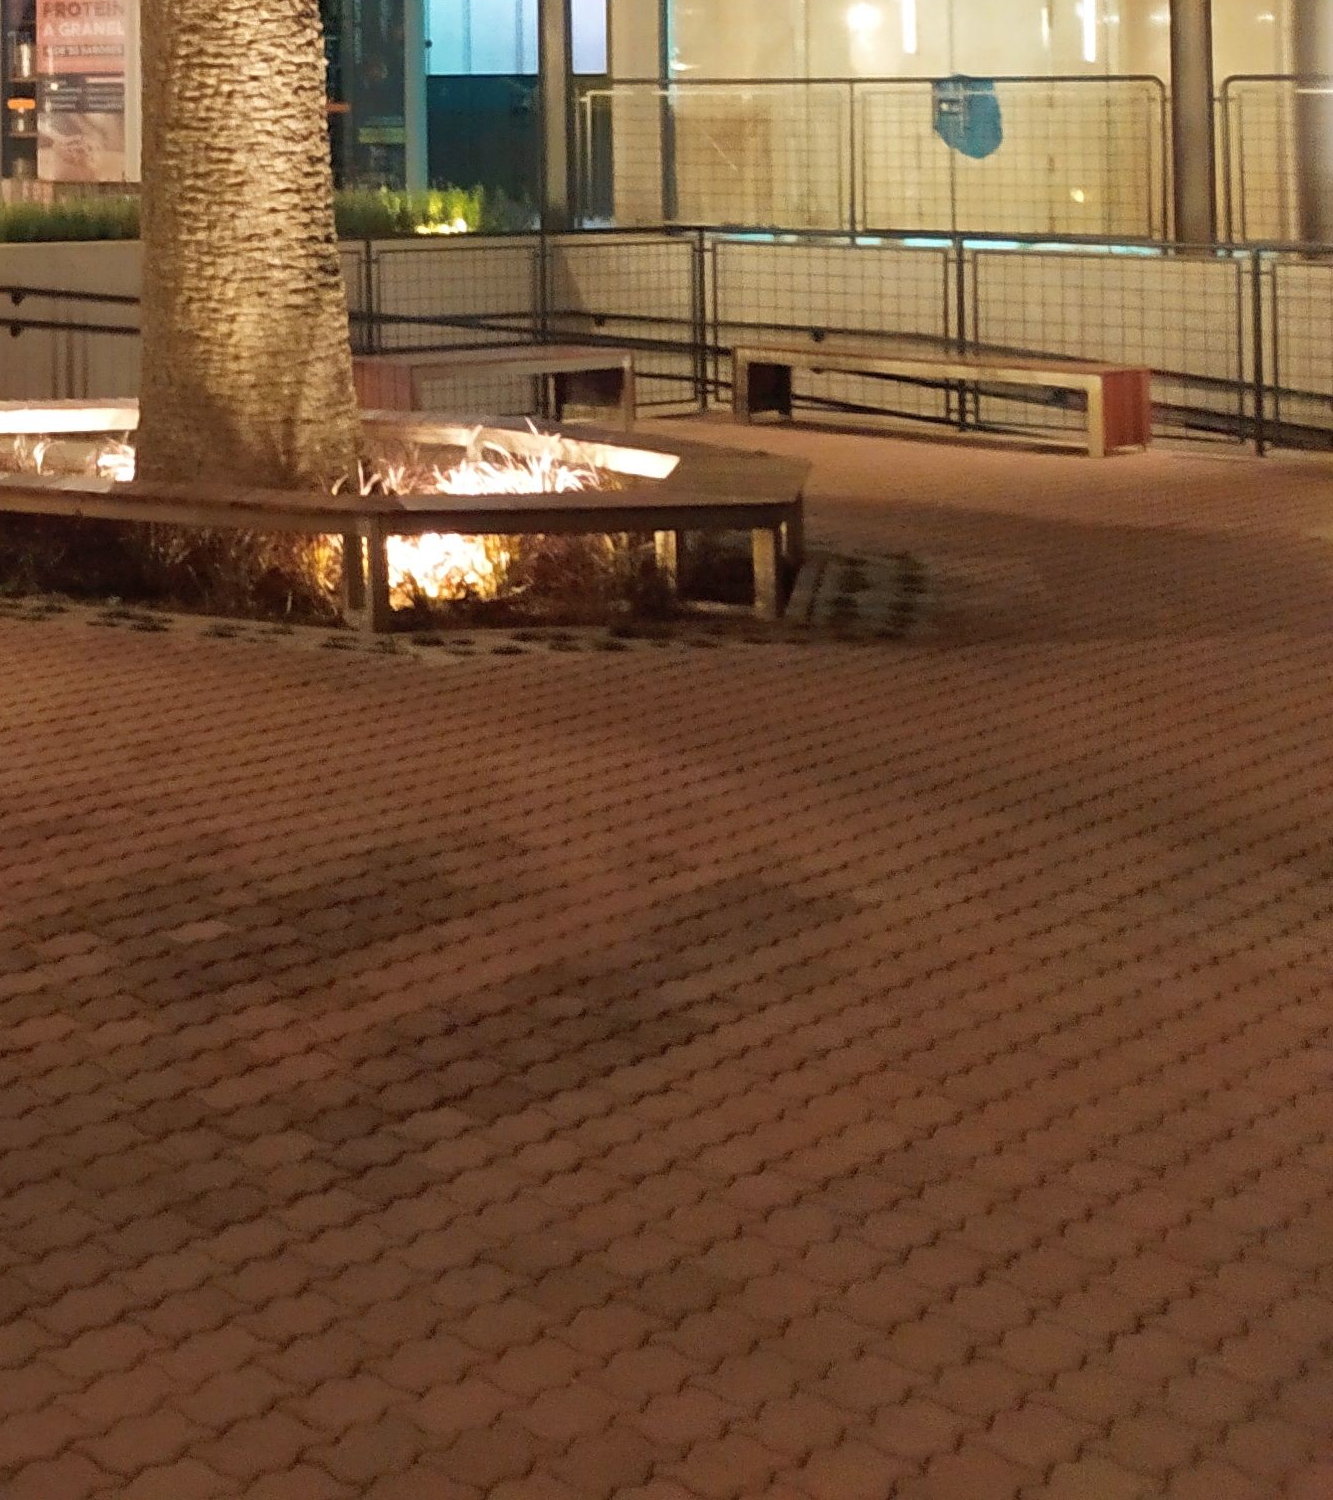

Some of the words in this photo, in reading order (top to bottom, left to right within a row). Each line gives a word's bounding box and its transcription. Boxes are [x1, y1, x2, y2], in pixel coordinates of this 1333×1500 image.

[43, 0, 126, 18] PROTEIN
[43, 22, 54, 37] A
[58, 18, 126, 37] GRANEL
